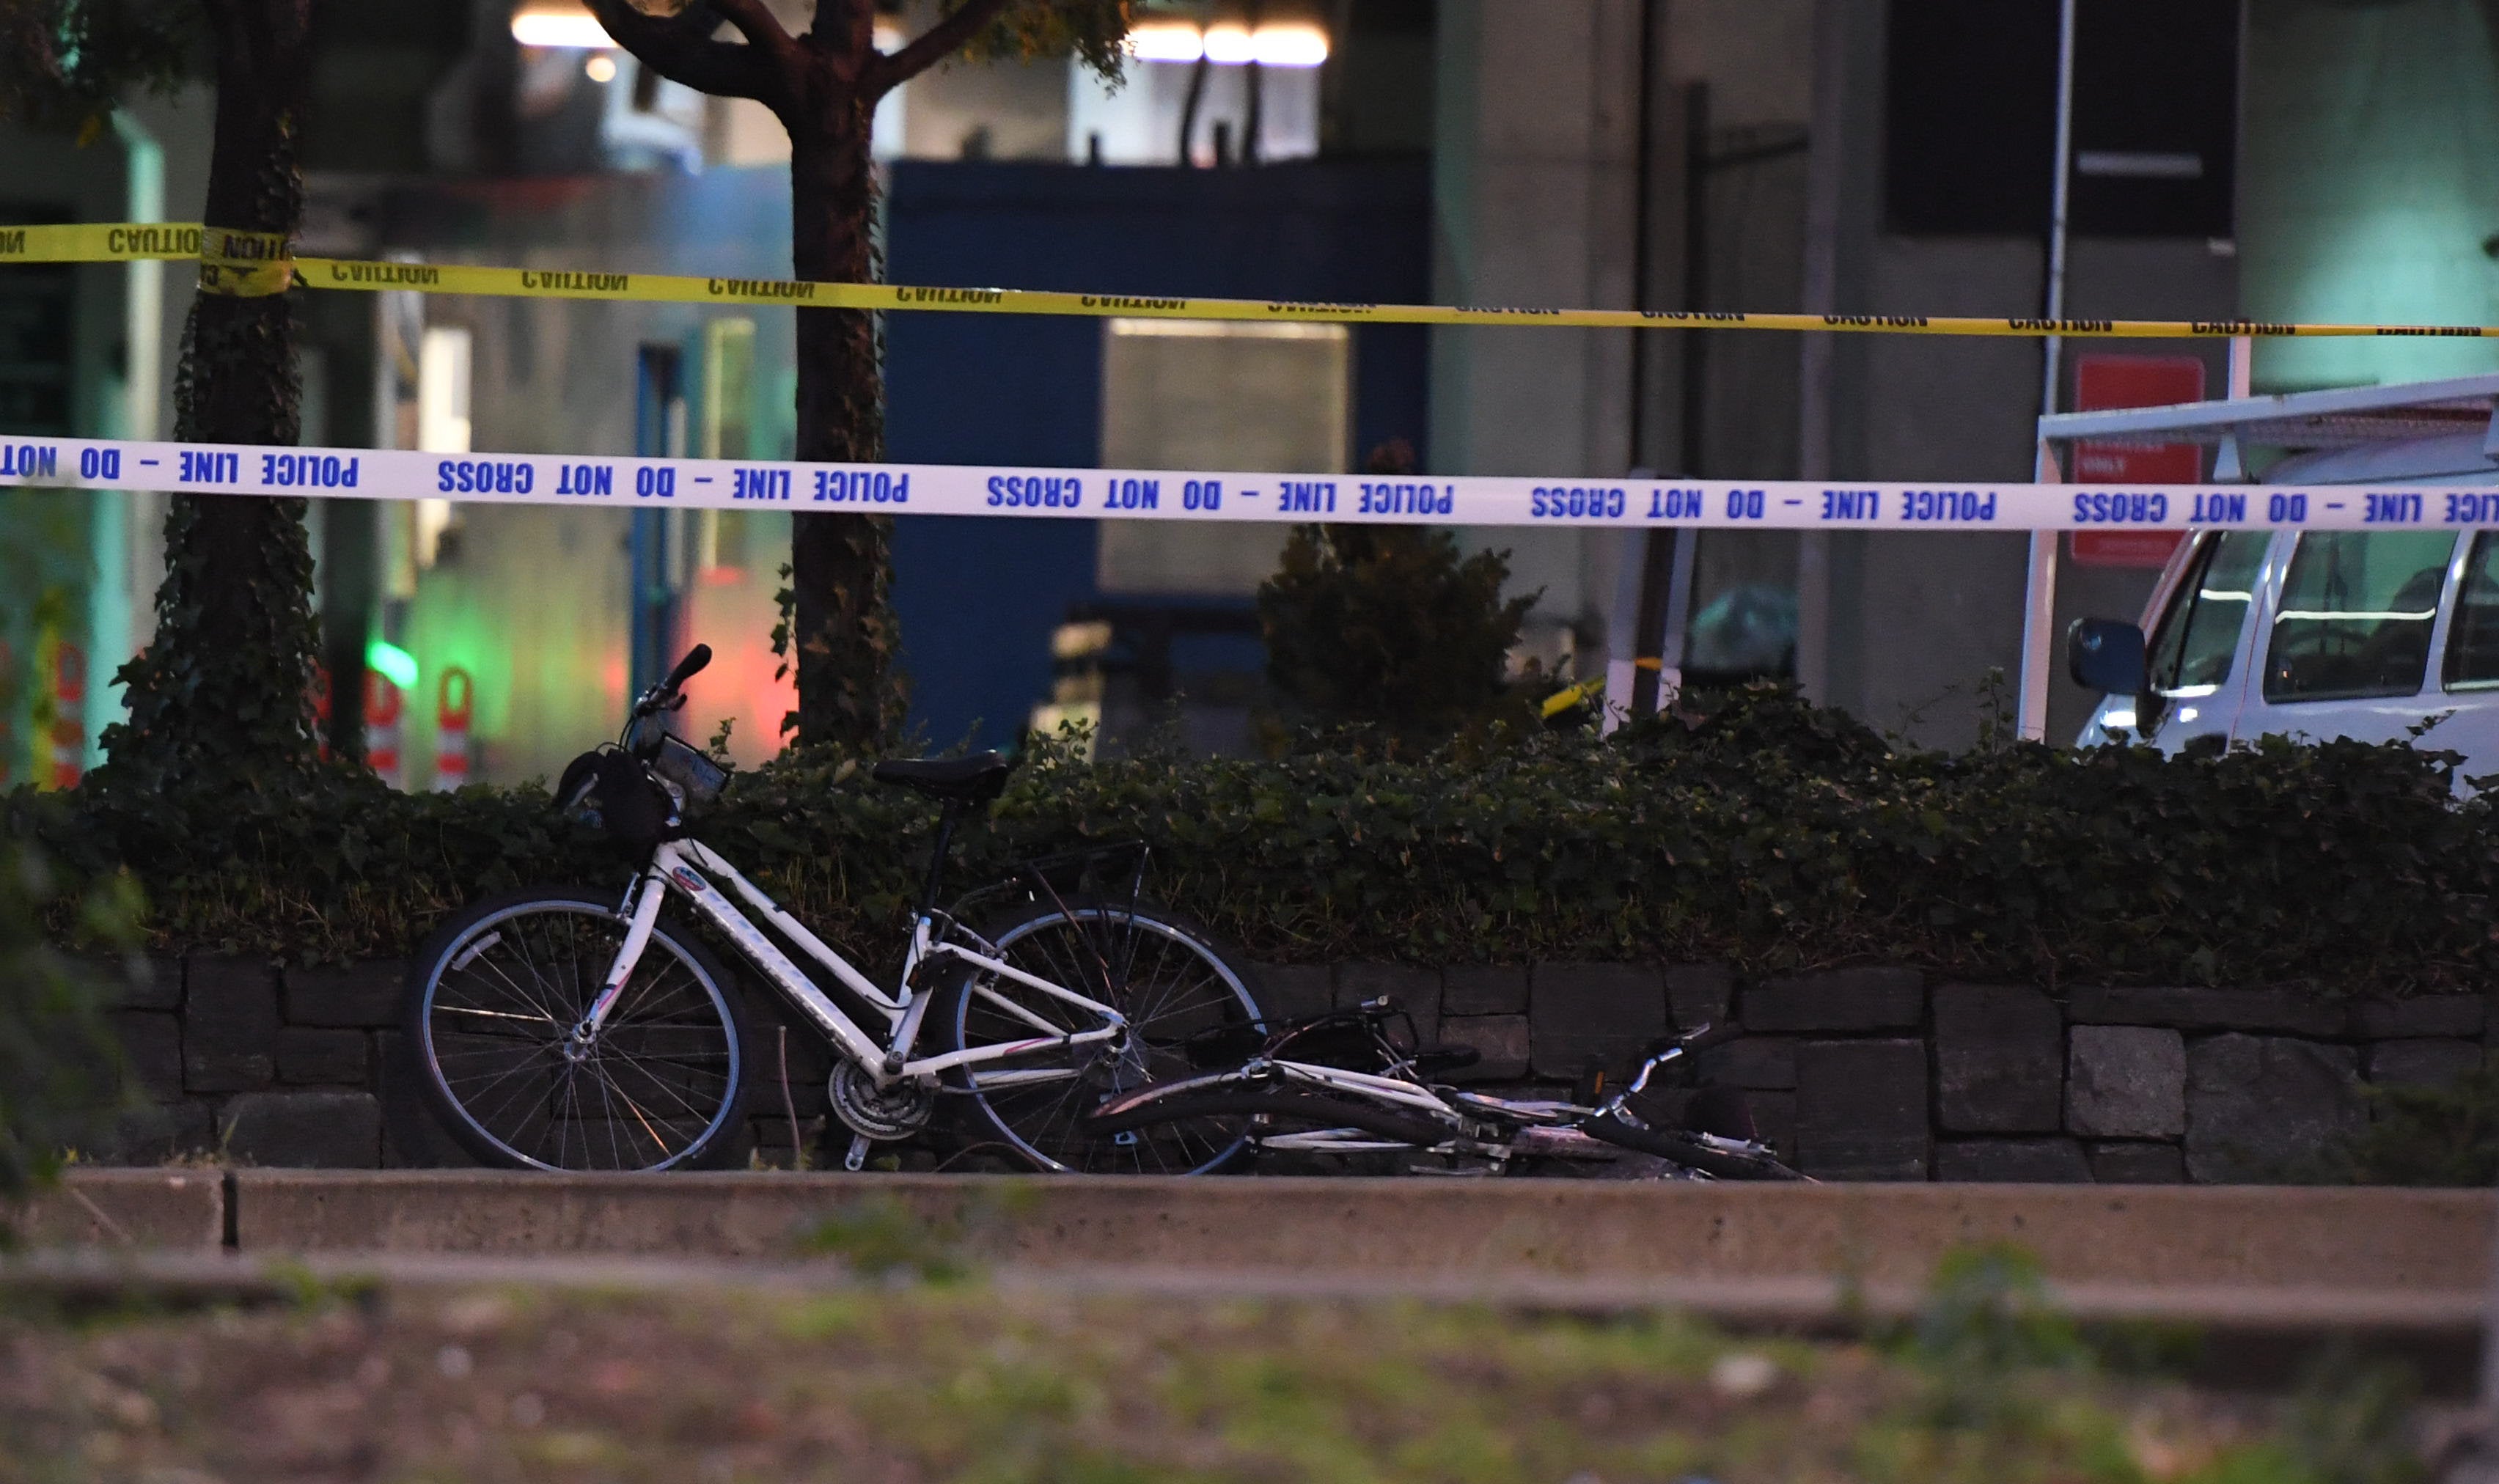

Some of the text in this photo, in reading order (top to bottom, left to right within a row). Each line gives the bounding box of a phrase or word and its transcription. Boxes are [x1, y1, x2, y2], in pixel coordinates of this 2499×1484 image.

[0, 444, 56, 480] NOT
[80, 447, 120, 480] DO
[179, 451, 238, 484] LINE
[261, 454, 359, 488] POLICE
[438, 460, 534, 494] CROSS
[556, 464, 613, 496] NOT
[636, 466, 675, 498] DO
[733, 469, 790, 500] LINE
[813, 471, 909, 503] POLICE
[987, 476, 1082, 508] CROSS
[1103, 479, 1159, 510] NOT
[1183, 480, 1222, 511] DO
[1278, 482, 1336, 513] LINE
[1358, 483, 1453, 515] POLICE
[1530, 487, 1626, 518] CROSS
[1646, 488, 1703, 519] NOT
[1726, 489, 1764, 520] DO
[1821, 490, 1879, 521] LINE
[1900, 491, 1996, 521] POLICE
[2073, 493, 2168, 524] CROSS
[2188, 493, 2246, 524] NOT
[2267, 493, 2308, 524] DO
[2363, 493, 2422, 524] LINE
